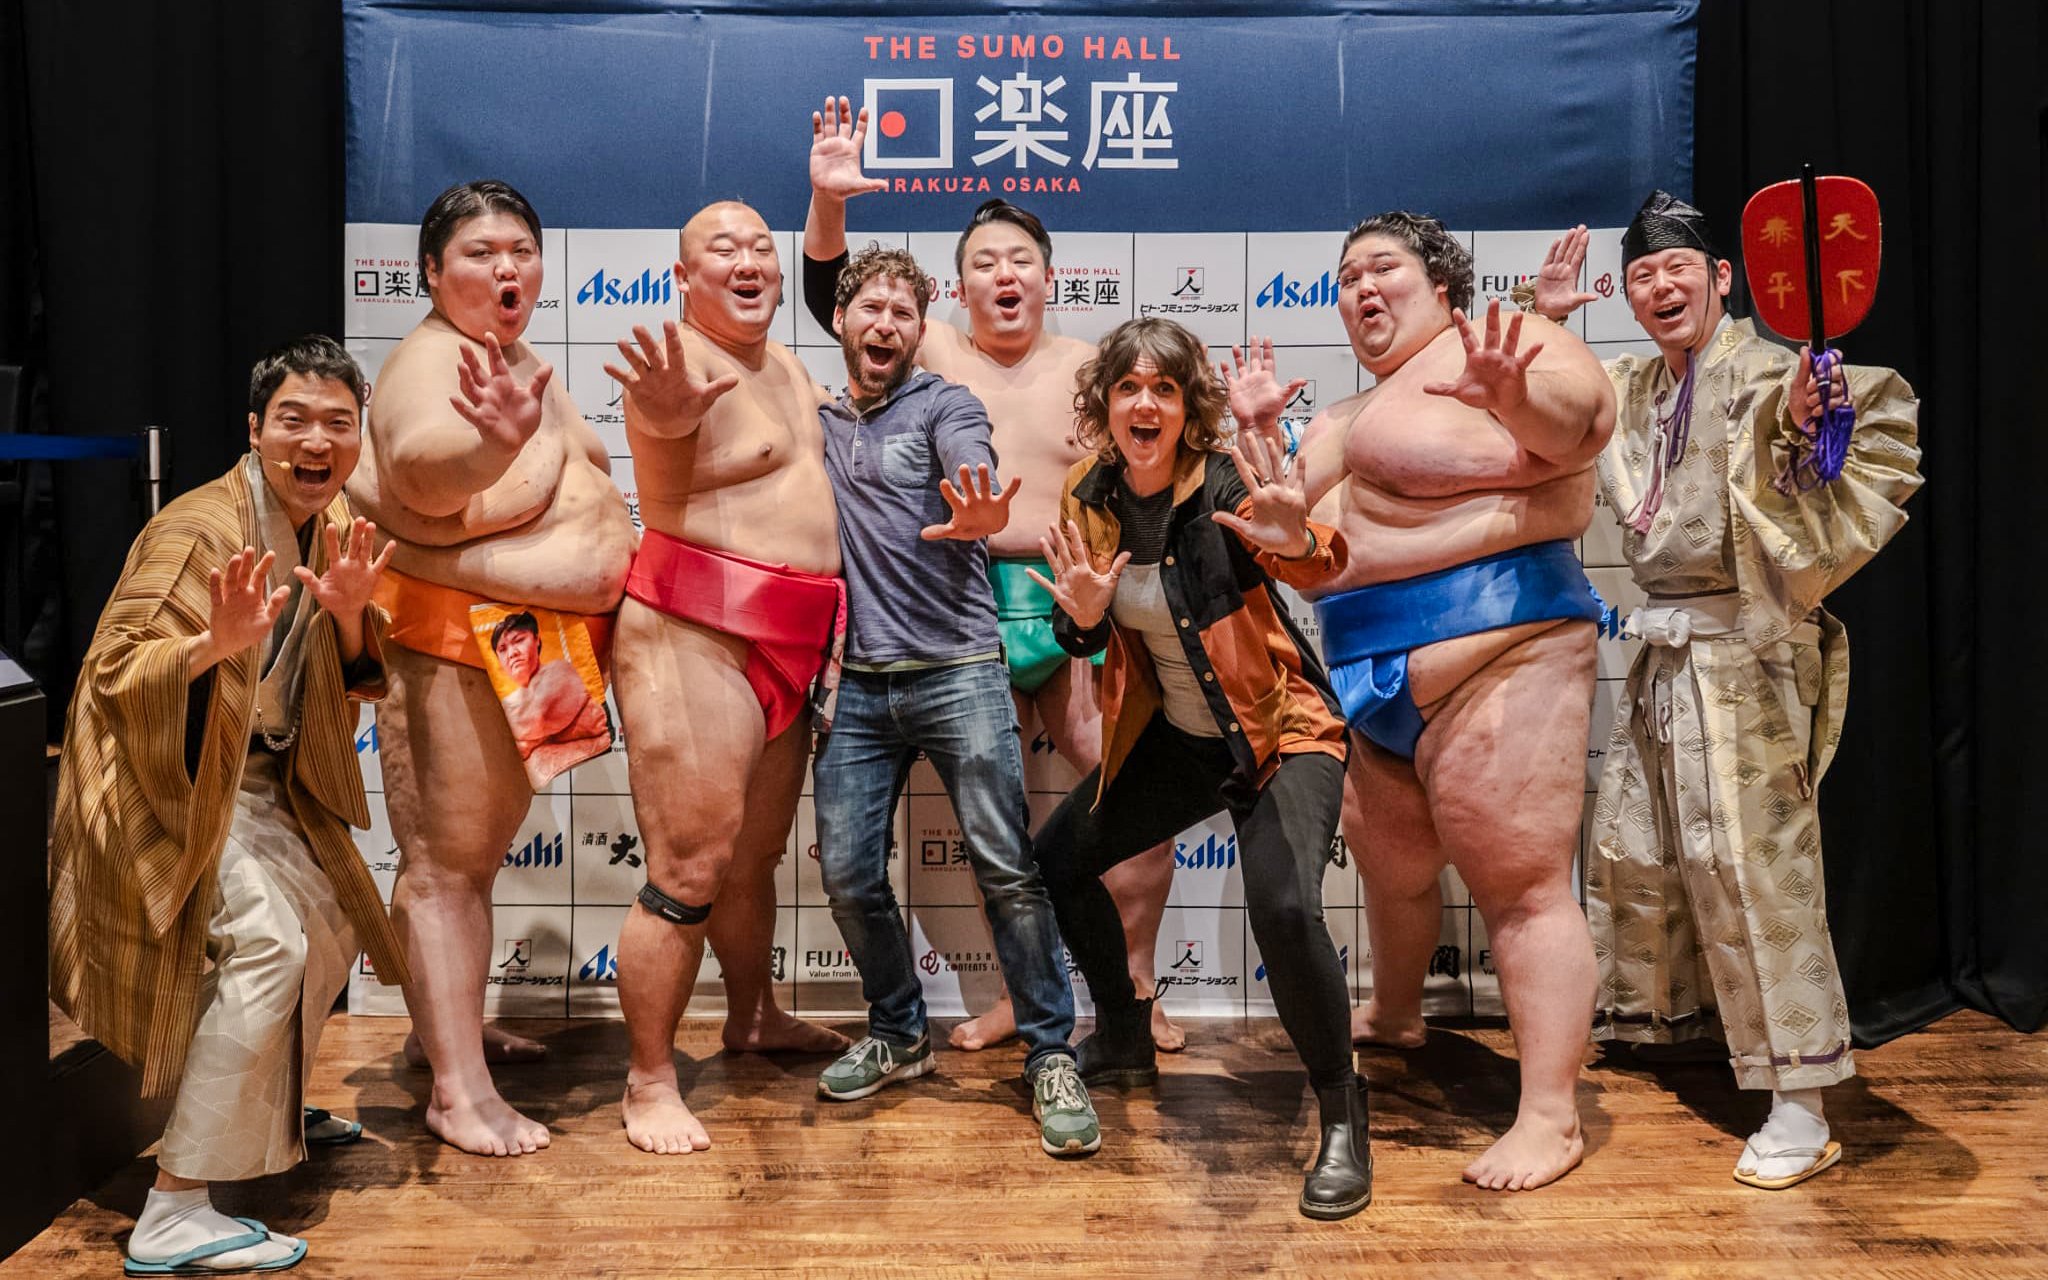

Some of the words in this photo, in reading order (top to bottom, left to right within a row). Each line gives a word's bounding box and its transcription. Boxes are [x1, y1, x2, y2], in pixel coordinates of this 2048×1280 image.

[864, 36, 937, 60] THE
[957, 34, 1064, 59] SUMO
[1084, 36, 1182, 60] HALL
[882, 177, 991, 193] IRAKUZA
[1003, 177, 1082, 193] OSAKA
[355, 259, 375, 267] THE
[379, 259, 410, 268] SUMO
[1823, 213, 1869, 305] 天下
[1059, 268, 1089, 276] SUMO
[1093, 268, 1120, 276] HALL
[577, 268, 671, 305] Asahi
[1256, 270, 1341, 308] Asah
[1482, 275, 1538, 292] FUJI
[500, 832, 563, 869] sahi
[1174, 833, 1236, 870] sahi
[806, 950, 856, 968] FUJI
[945, 952, 992, 961] KANSA
[809, 970, 831, 978] Value
[833, 970, 852, 978] from
[1483, 967, 1497, 975] Val
